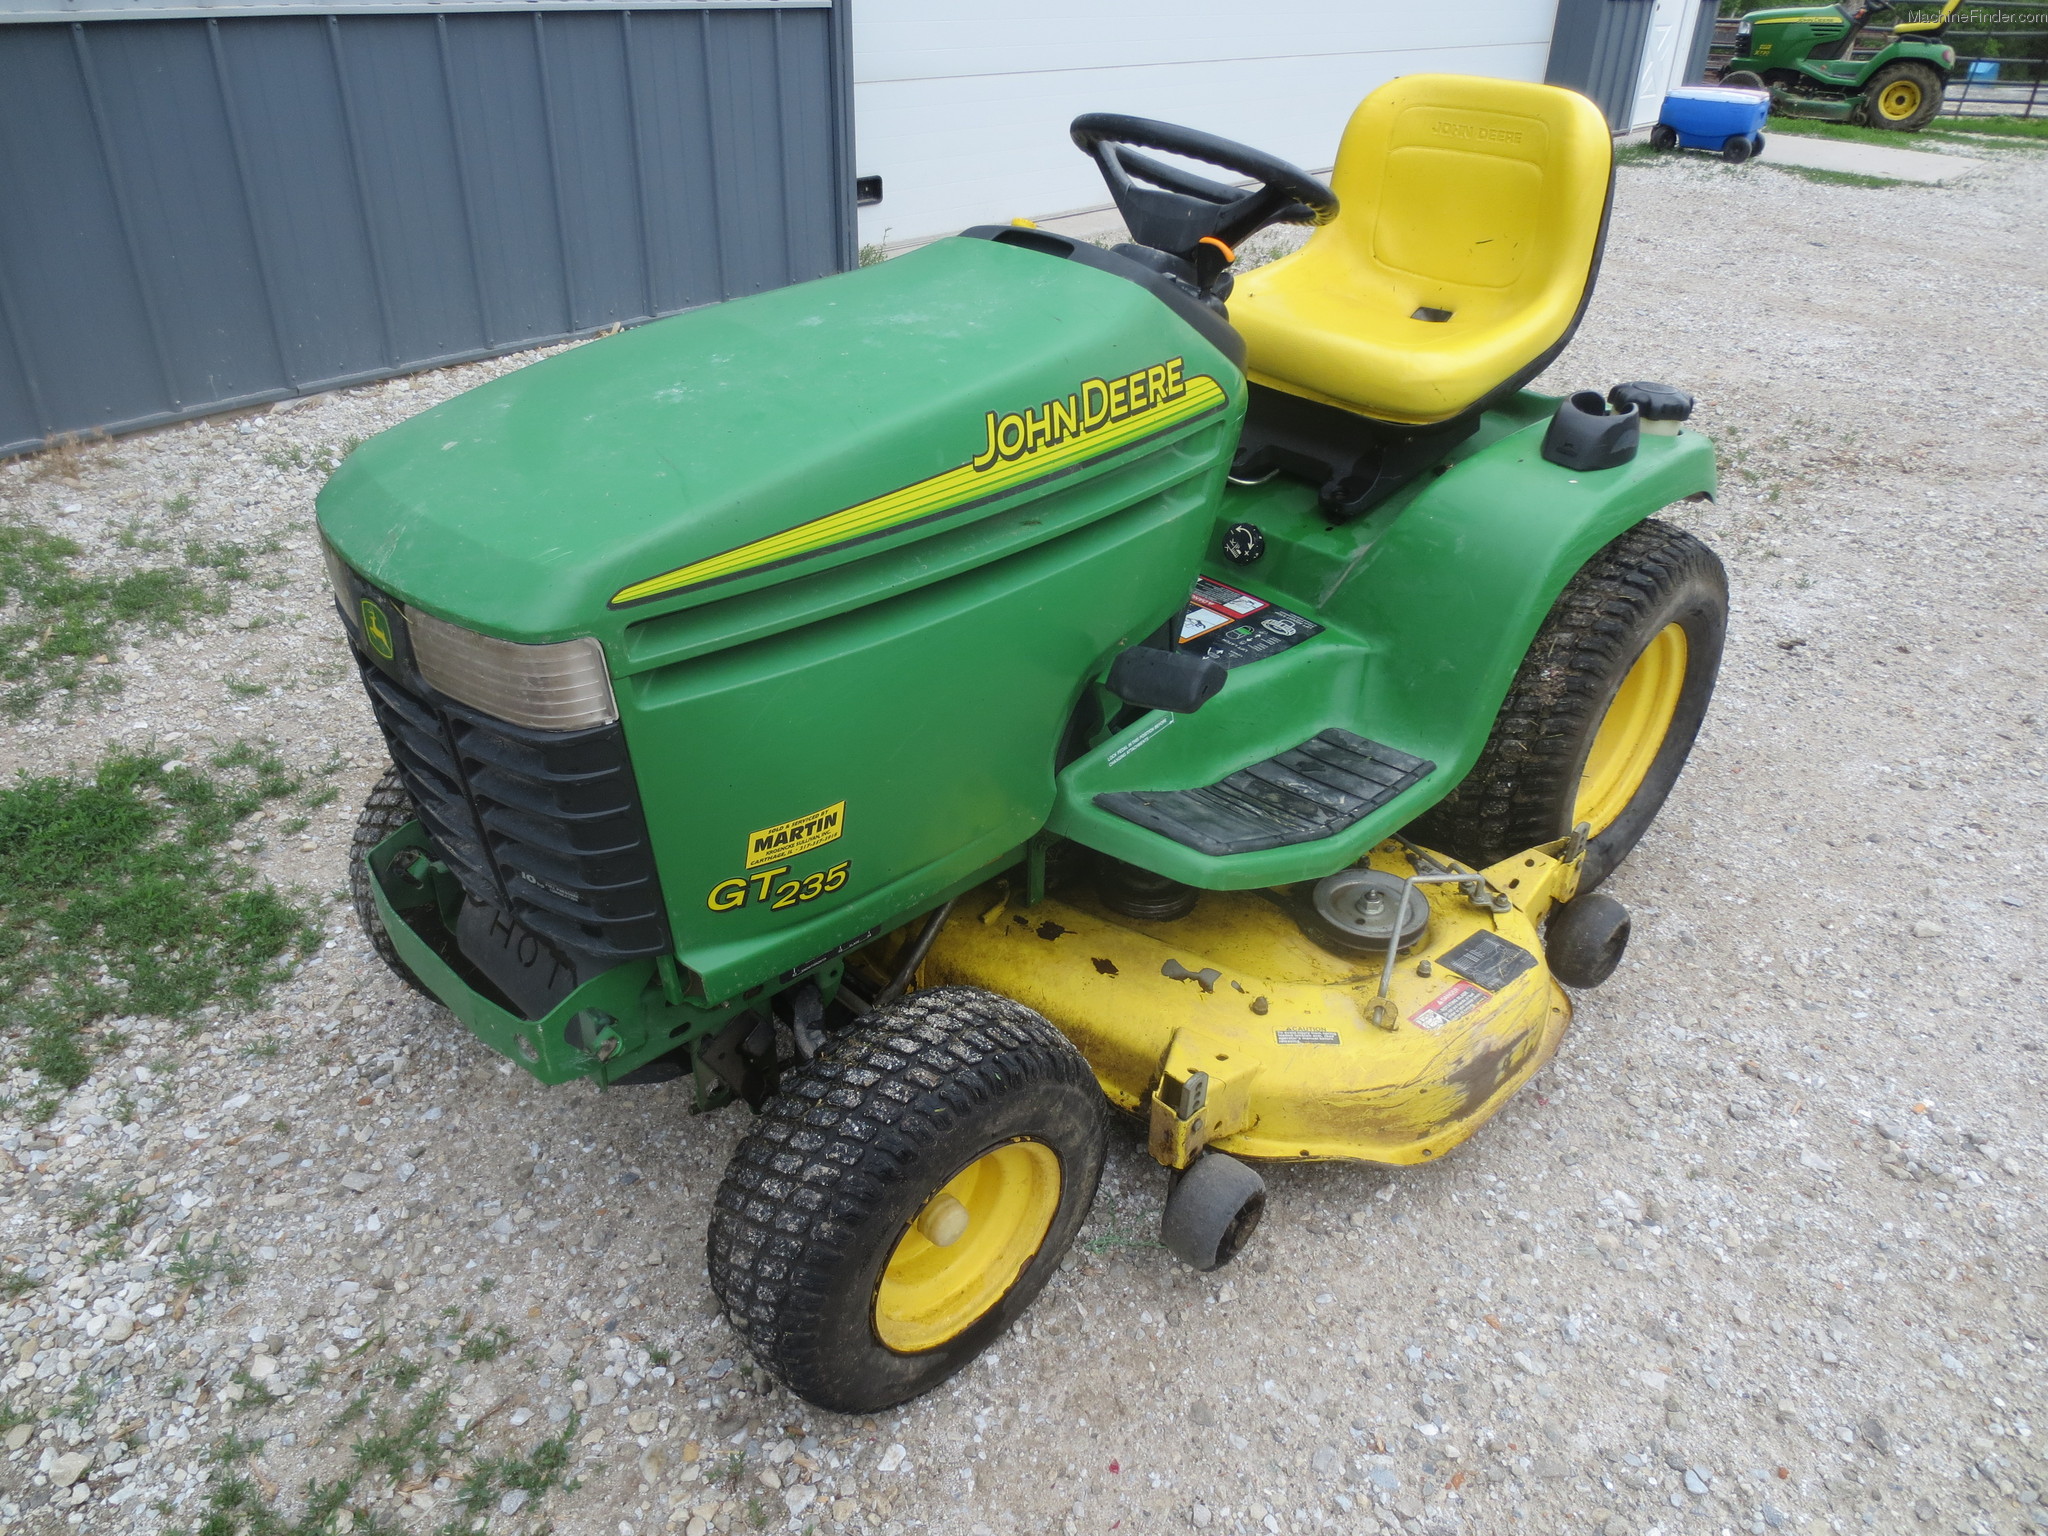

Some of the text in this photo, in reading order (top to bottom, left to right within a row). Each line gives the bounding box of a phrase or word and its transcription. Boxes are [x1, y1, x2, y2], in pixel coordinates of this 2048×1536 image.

[1432, 122, 1523, 145] JOHN DEERE
[973, 356, 1186, 472] JOHN DEERE
[754, 812, 838, 853] MARTIN
[768, 824, 785, 834] SOLD
[791, 813, 820, 828] SERVICED
[707, 860, 852, 913] GT235
